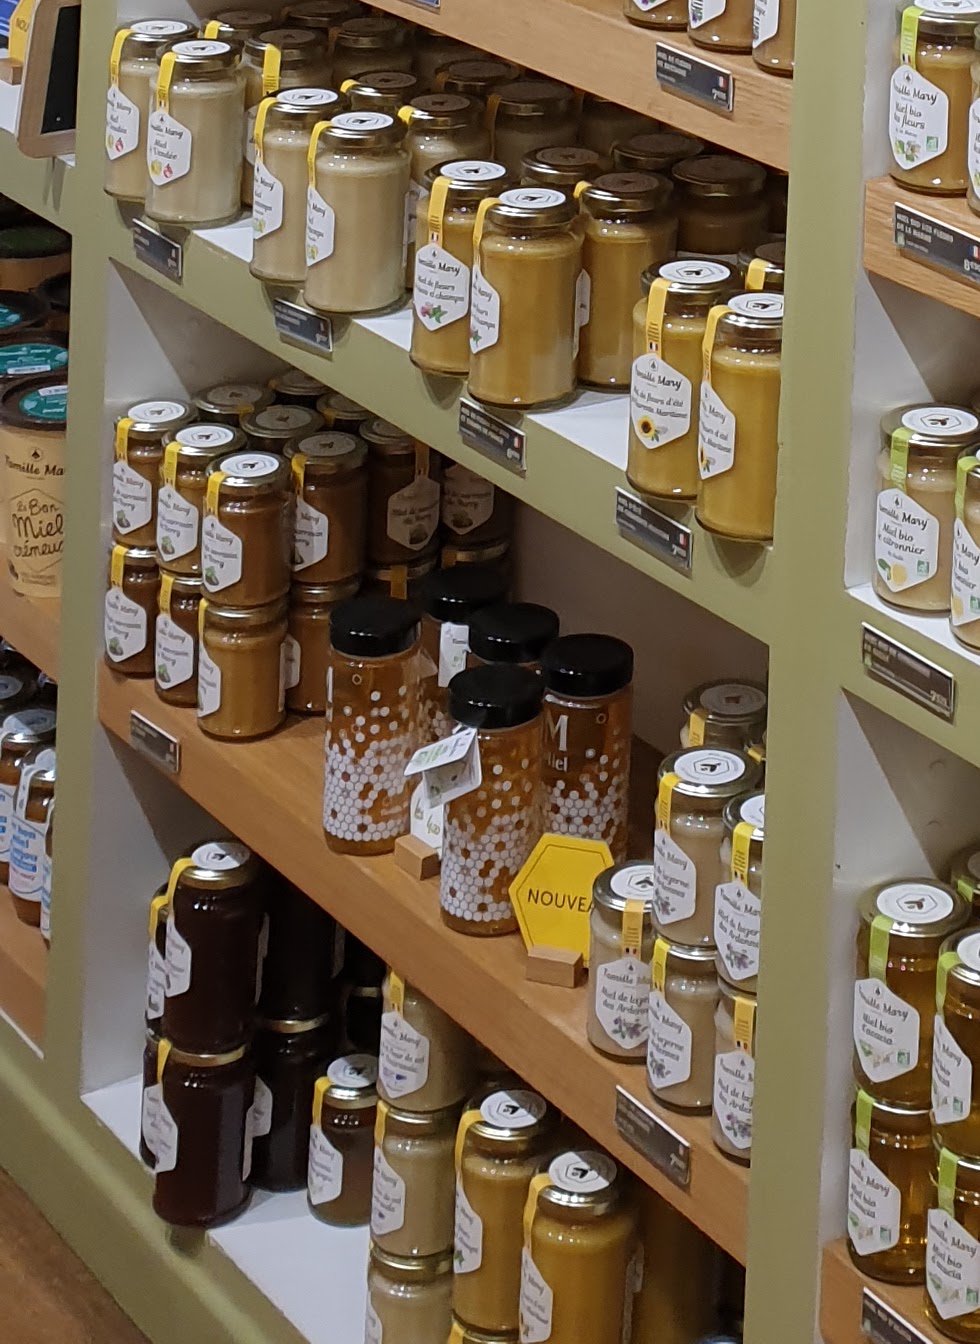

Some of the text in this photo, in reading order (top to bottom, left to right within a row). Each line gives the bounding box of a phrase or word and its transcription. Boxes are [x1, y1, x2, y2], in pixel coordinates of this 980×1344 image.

[912, 87, 938, 106] Mary
[438, 261, 461, 276] Mary
[658, 375, 682, 391] Mary
[5, 455, 40, 475] Famille
[29, 498, 58, 516] Bon
[12, 513, 63, 539] Miel
[898, 529, 914, 542] bio
